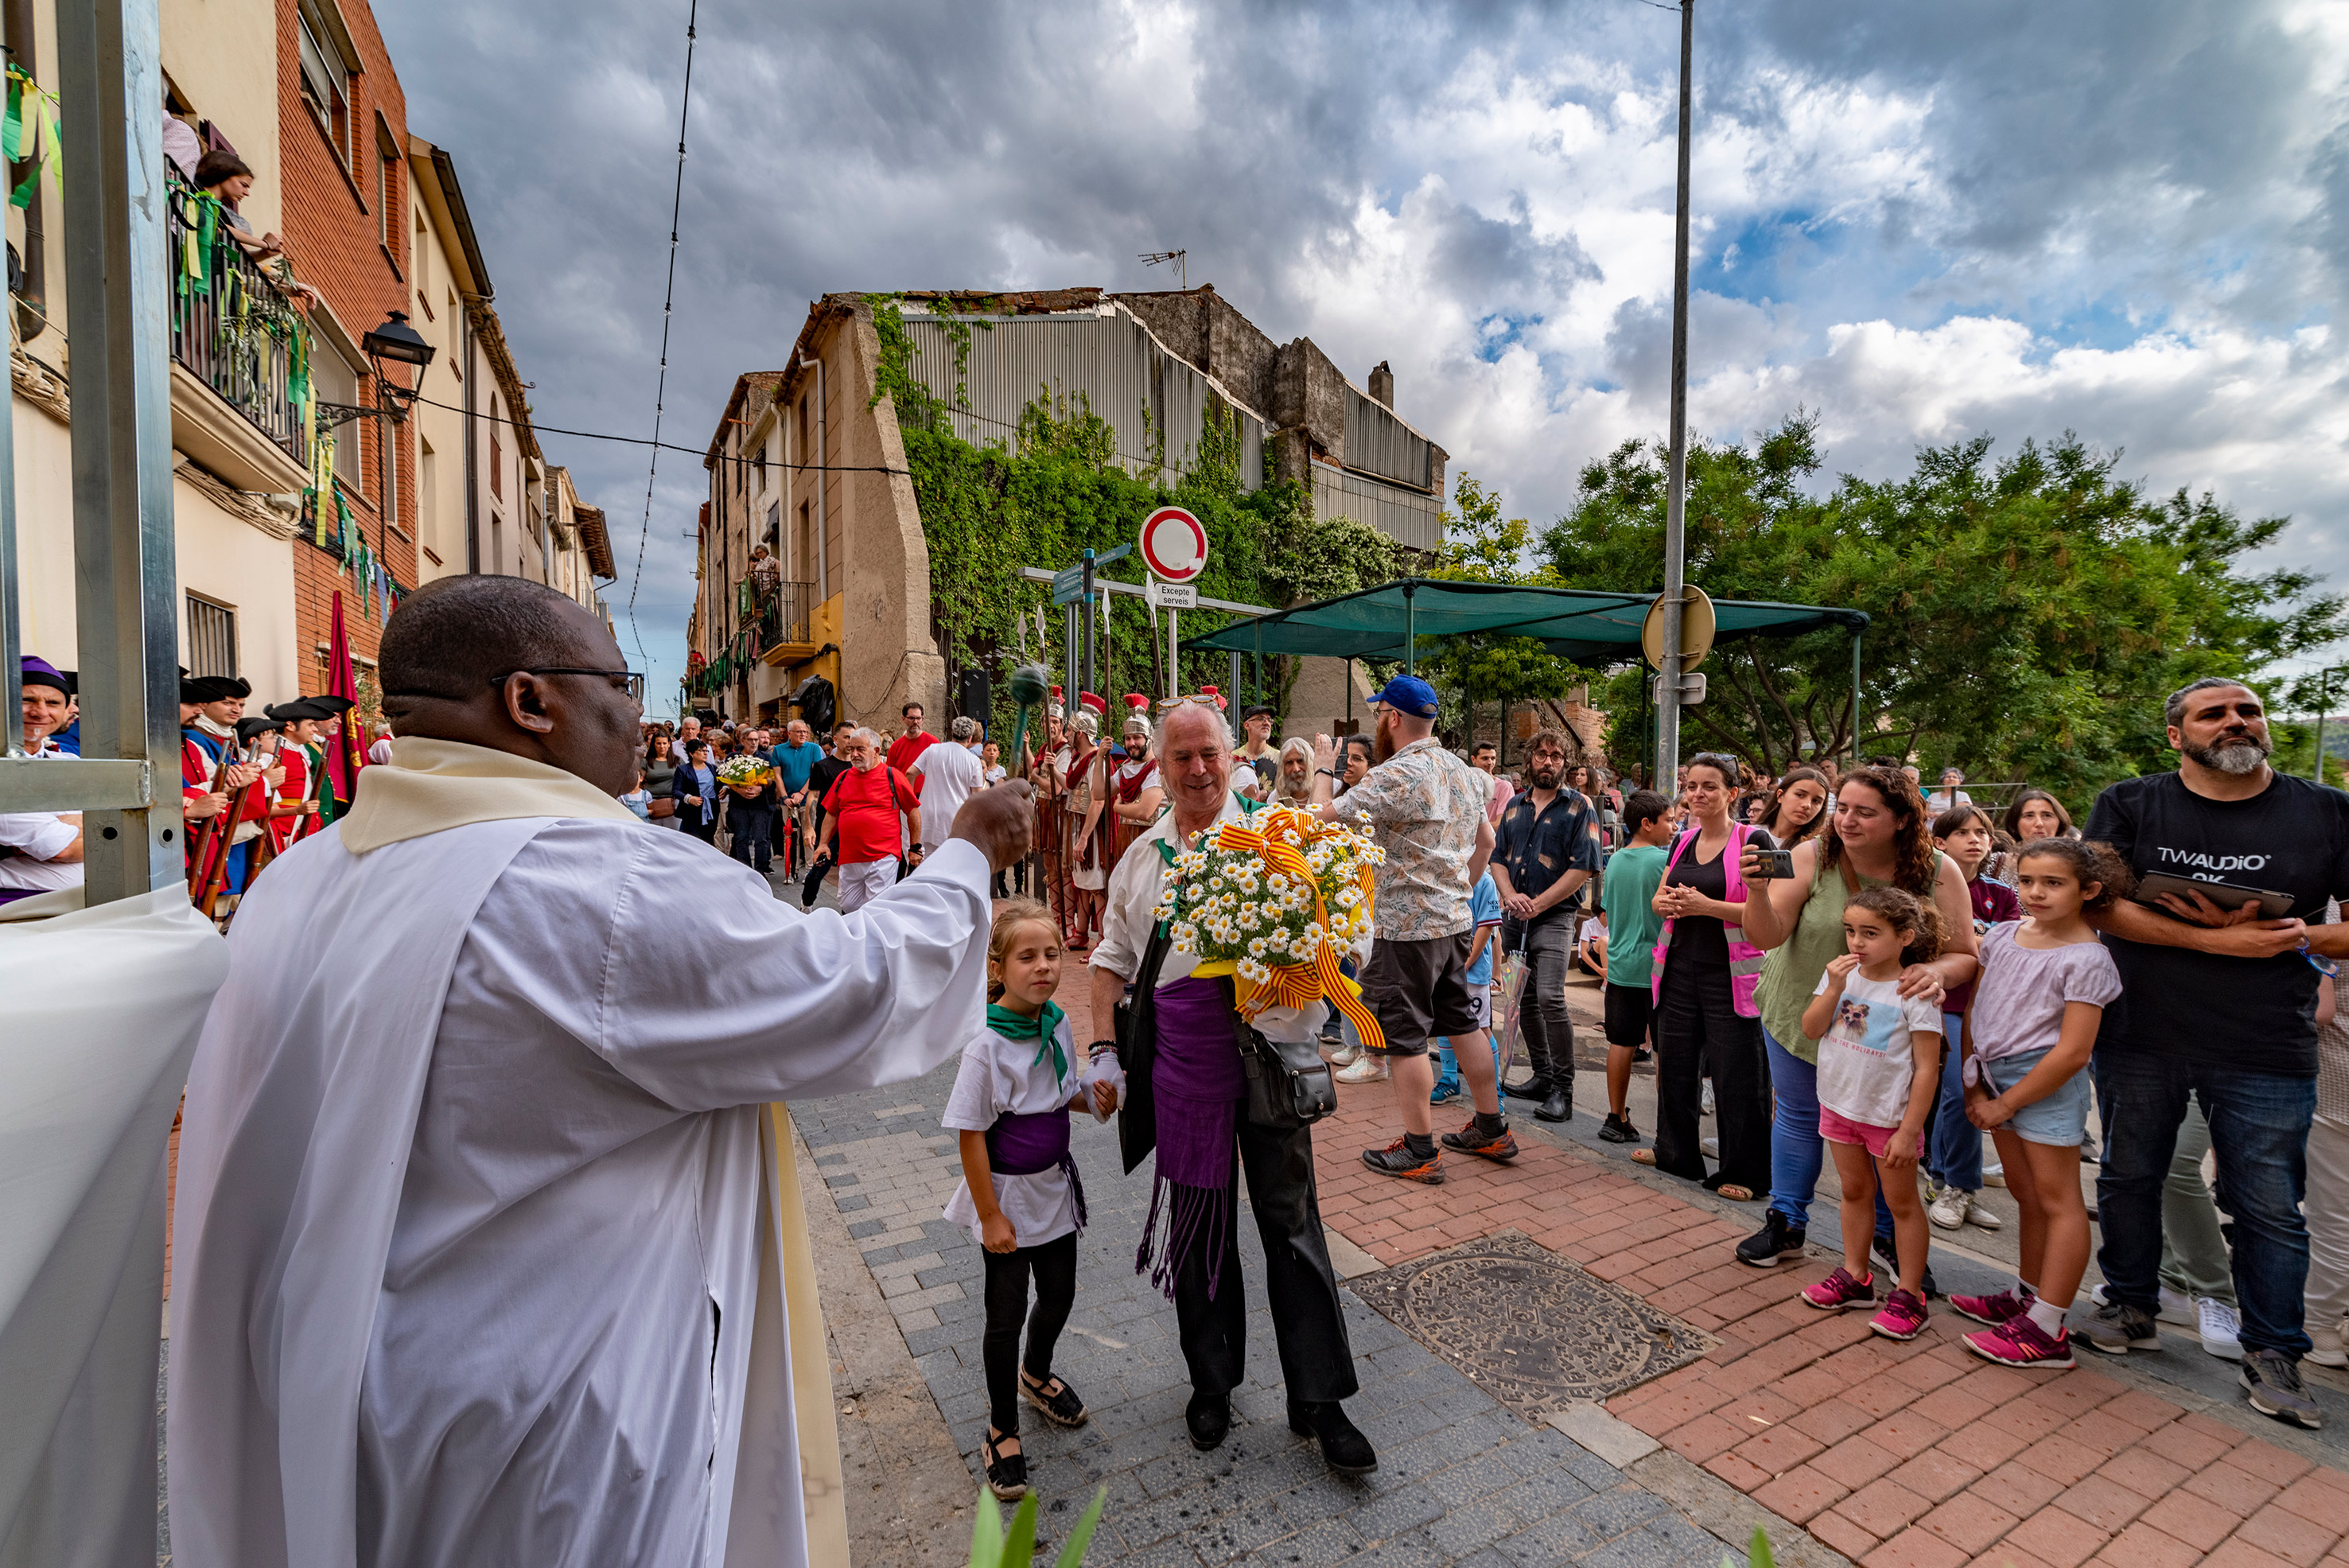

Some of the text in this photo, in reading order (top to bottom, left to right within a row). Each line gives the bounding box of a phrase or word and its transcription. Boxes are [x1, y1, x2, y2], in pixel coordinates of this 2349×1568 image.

[1161, 586, 1190, 597] Excepte
[1163, 597, 1188, 605] serveis
[1472, 996, 1483, 1015] 9
[1839, 1039, 1849, 1049] THE
[1851, 1043, 1887, 1058] HOLIDAYS!
